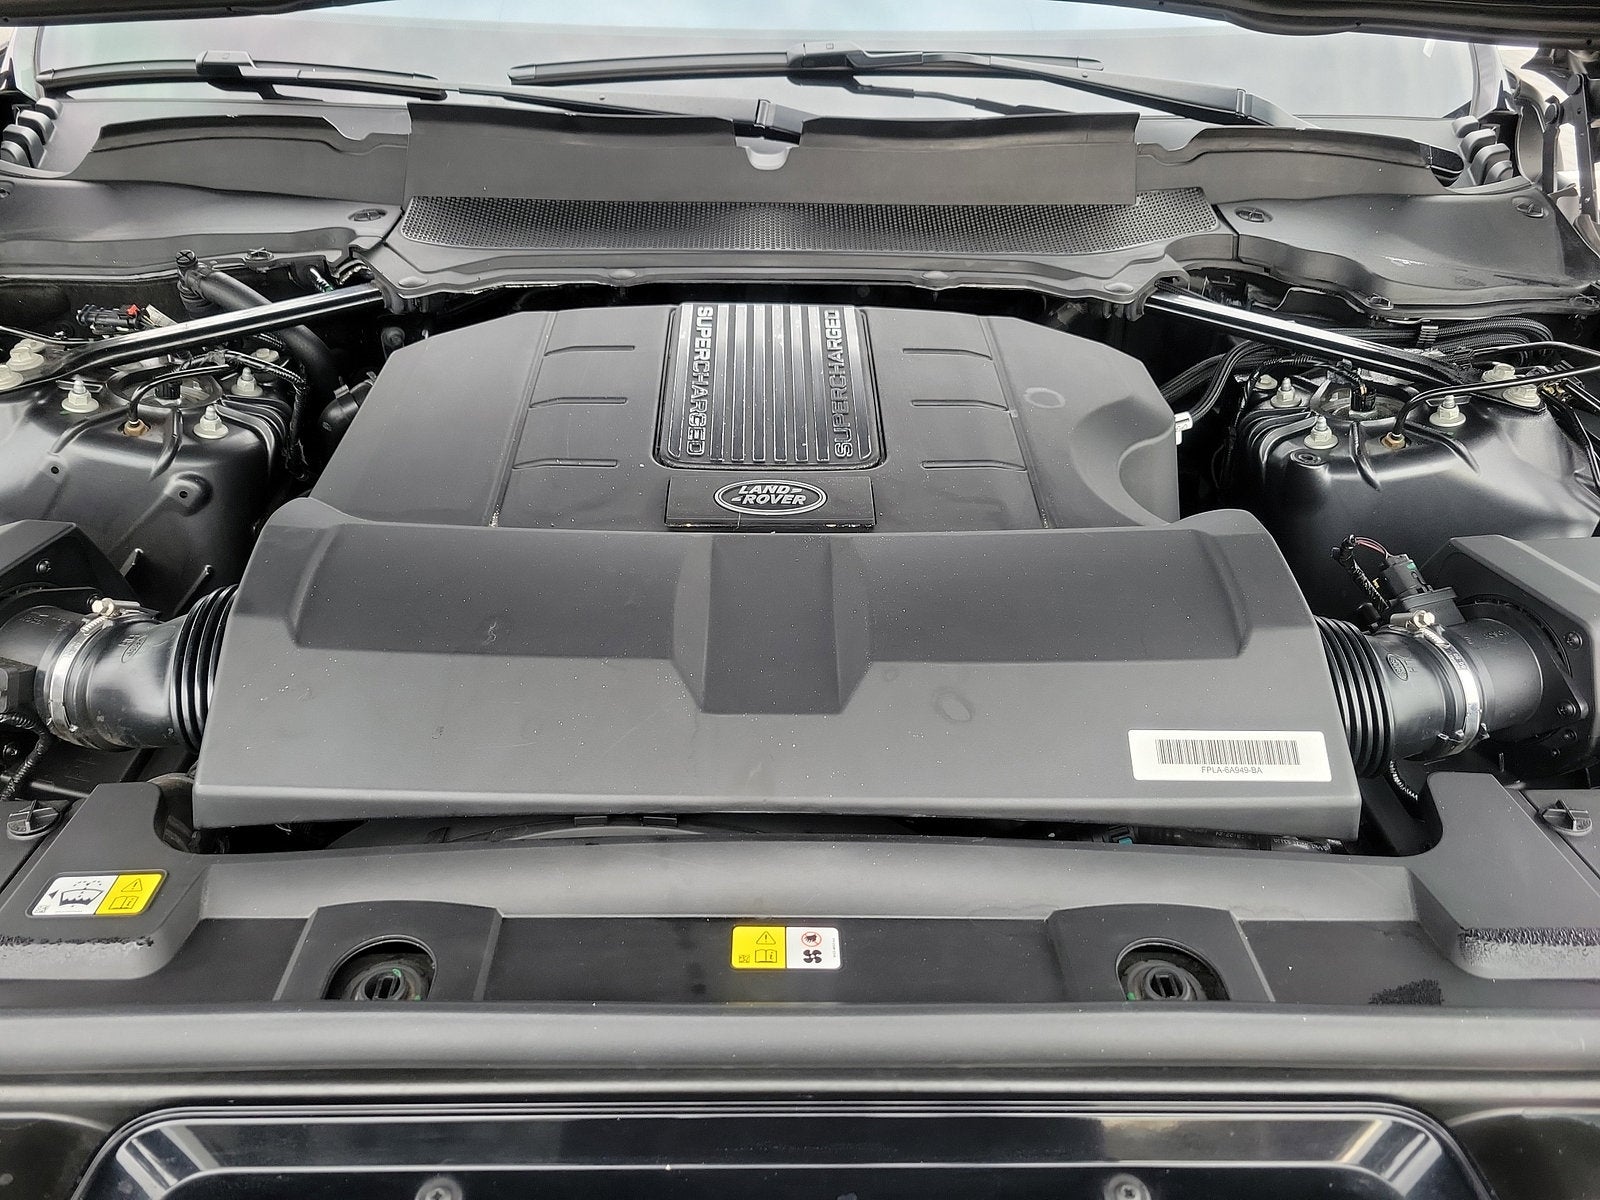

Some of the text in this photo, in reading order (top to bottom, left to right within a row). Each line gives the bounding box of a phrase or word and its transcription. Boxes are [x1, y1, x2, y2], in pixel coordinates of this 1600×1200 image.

[686, 305, 714, 457] SUPERCHARGED
[823, 308, 853, 458] SUPERCHARGED
[738, 485, 791, 495] LAND
[741, 494, 807, 505] ROVER
[1201, 765, 1264, 775] FPLA-6A949-BA
